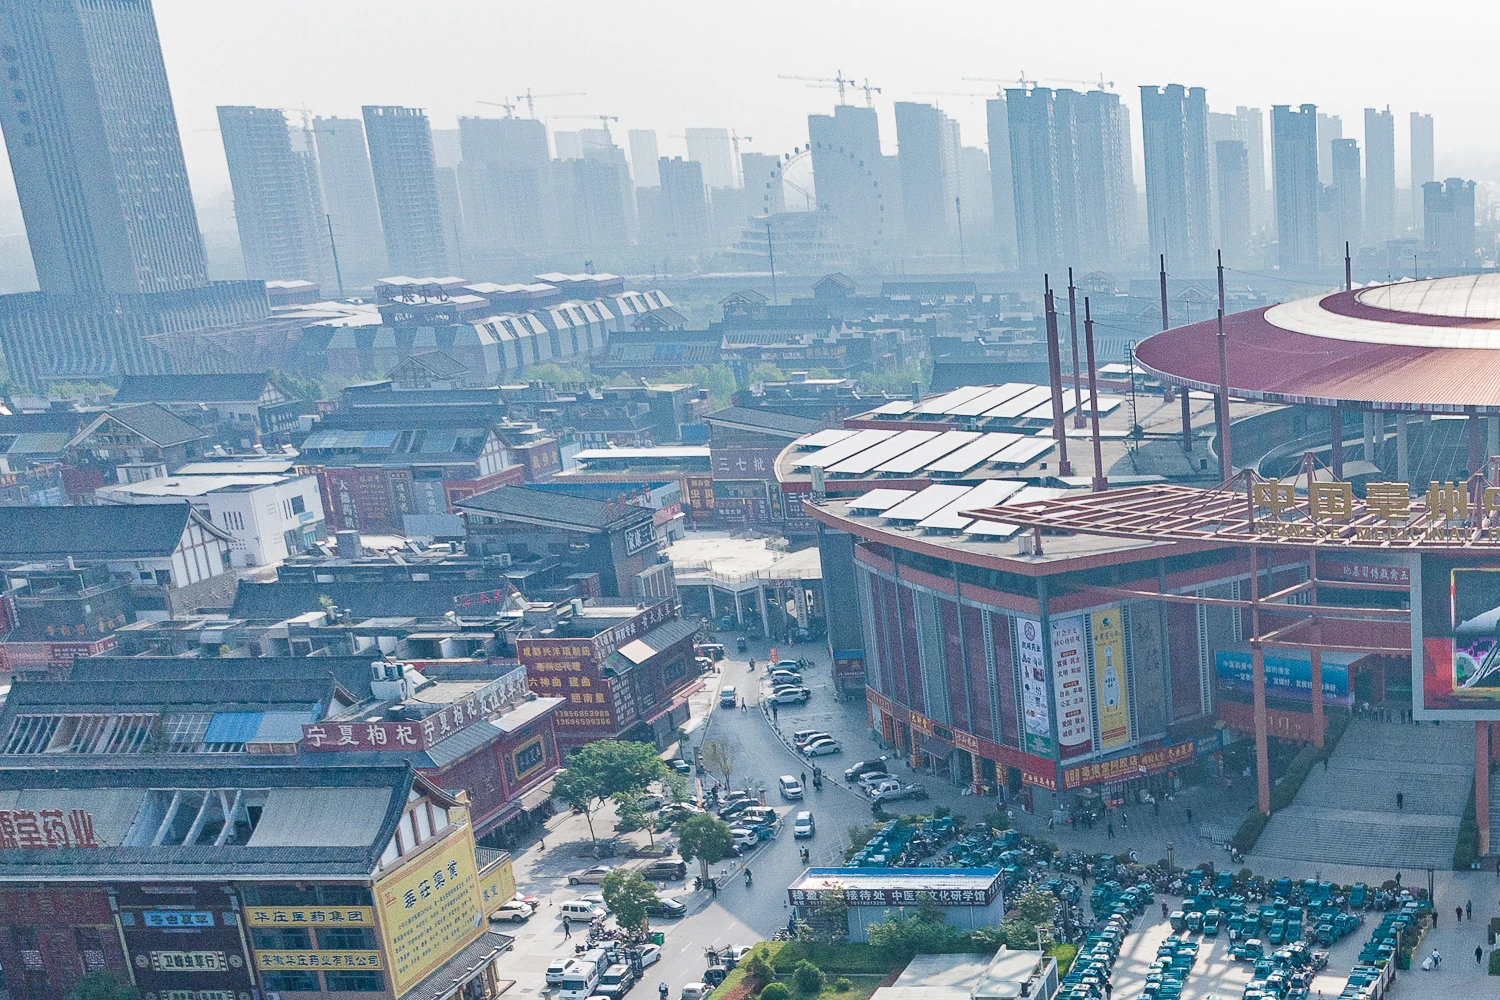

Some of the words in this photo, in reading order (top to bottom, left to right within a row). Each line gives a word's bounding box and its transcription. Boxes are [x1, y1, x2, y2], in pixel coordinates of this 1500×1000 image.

[718, 457, 775, 472] 三七批
[1254, 520, 1340, 539] CHINESE
[1356, 525, 1473, 542] MEDICINAL
[307, 726, 417, 748] 宁夏枸杞
[254, 911, 364, 923] 华庄医药集团
[262, 955, 378, 967] 安徽华庄药业有限公司
